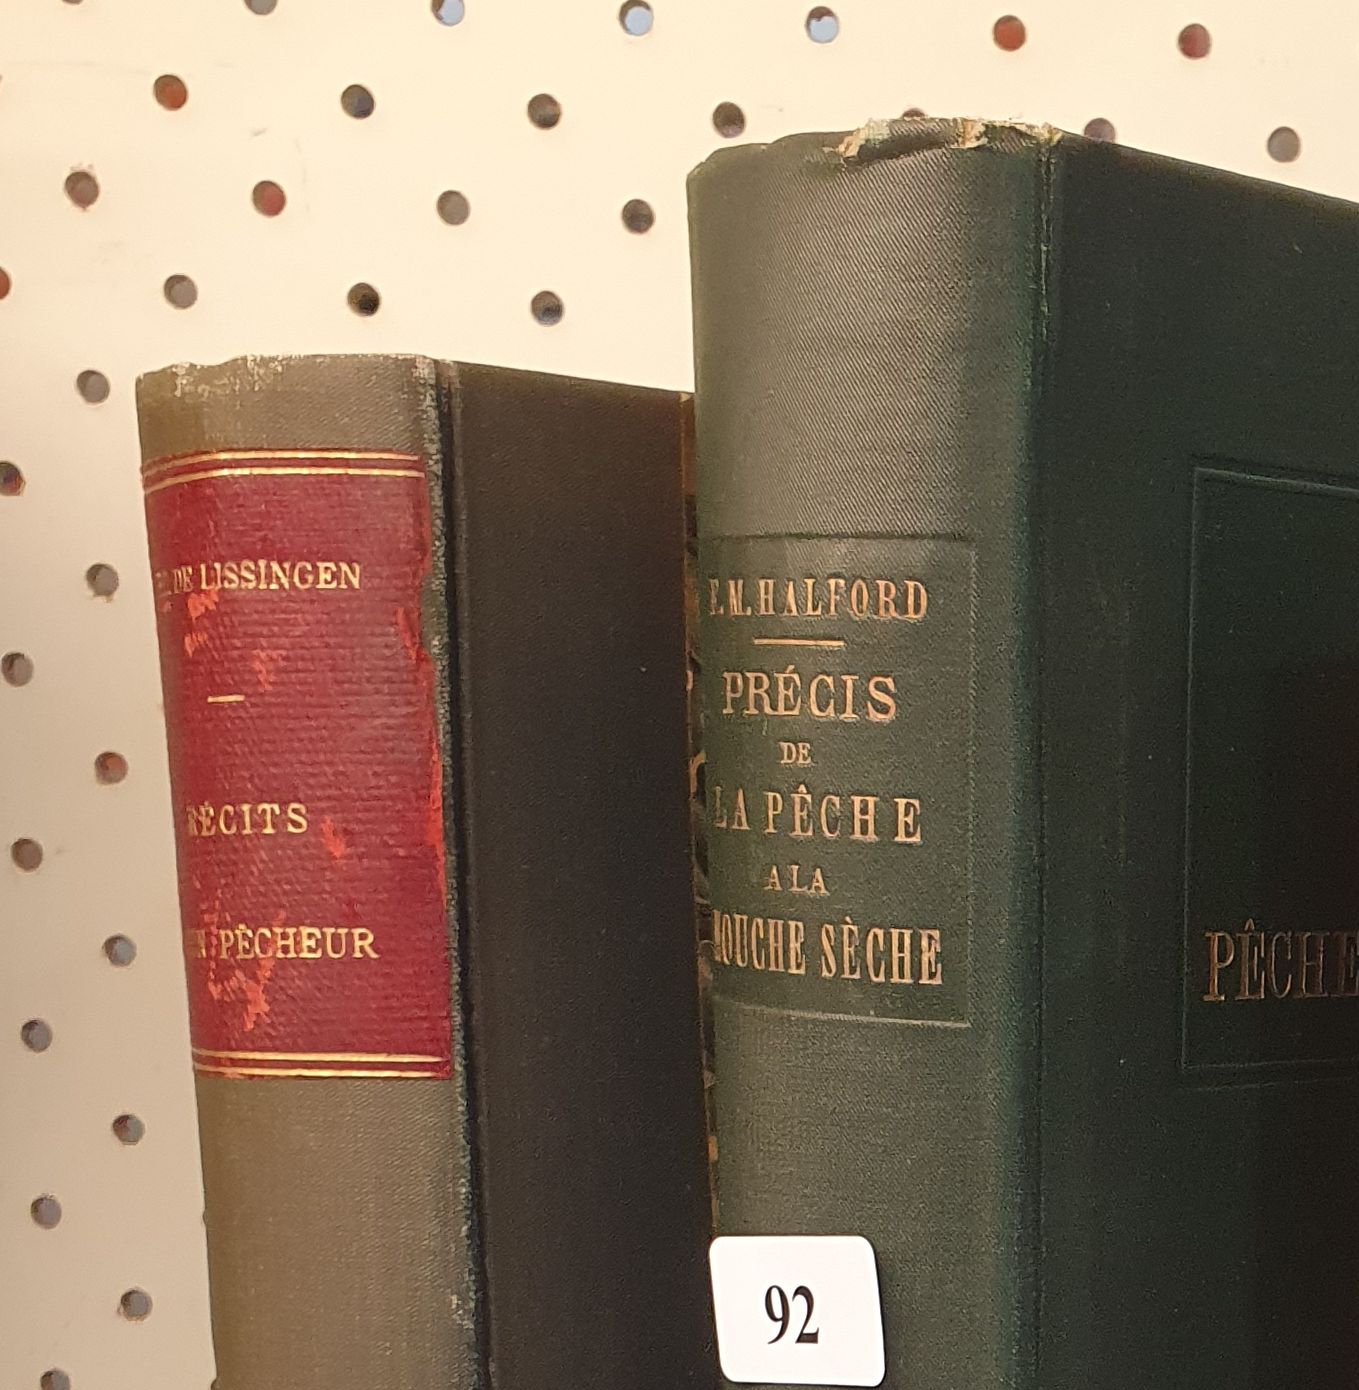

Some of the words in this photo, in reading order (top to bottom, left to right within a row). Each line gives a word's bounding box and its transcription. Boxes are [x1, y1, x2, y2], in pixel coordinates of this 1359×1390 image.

[200, 558, 362, 591] LISSINGEN
[722, 664, 898, 721] PRÉCIS
[778, 741, 813, 766] DE
[185, 800, 310, 837] RÉCITS
[713, 785, 751, 831] LA
[763, 783, 923, 844] PÊCHE
[787, 863, 831, 896] LA
[218, 922, 382, 960] PÊCHEUR
[820, 915, 944, 986] SÈCHE
[763, 1284, 821, 1346] 92
